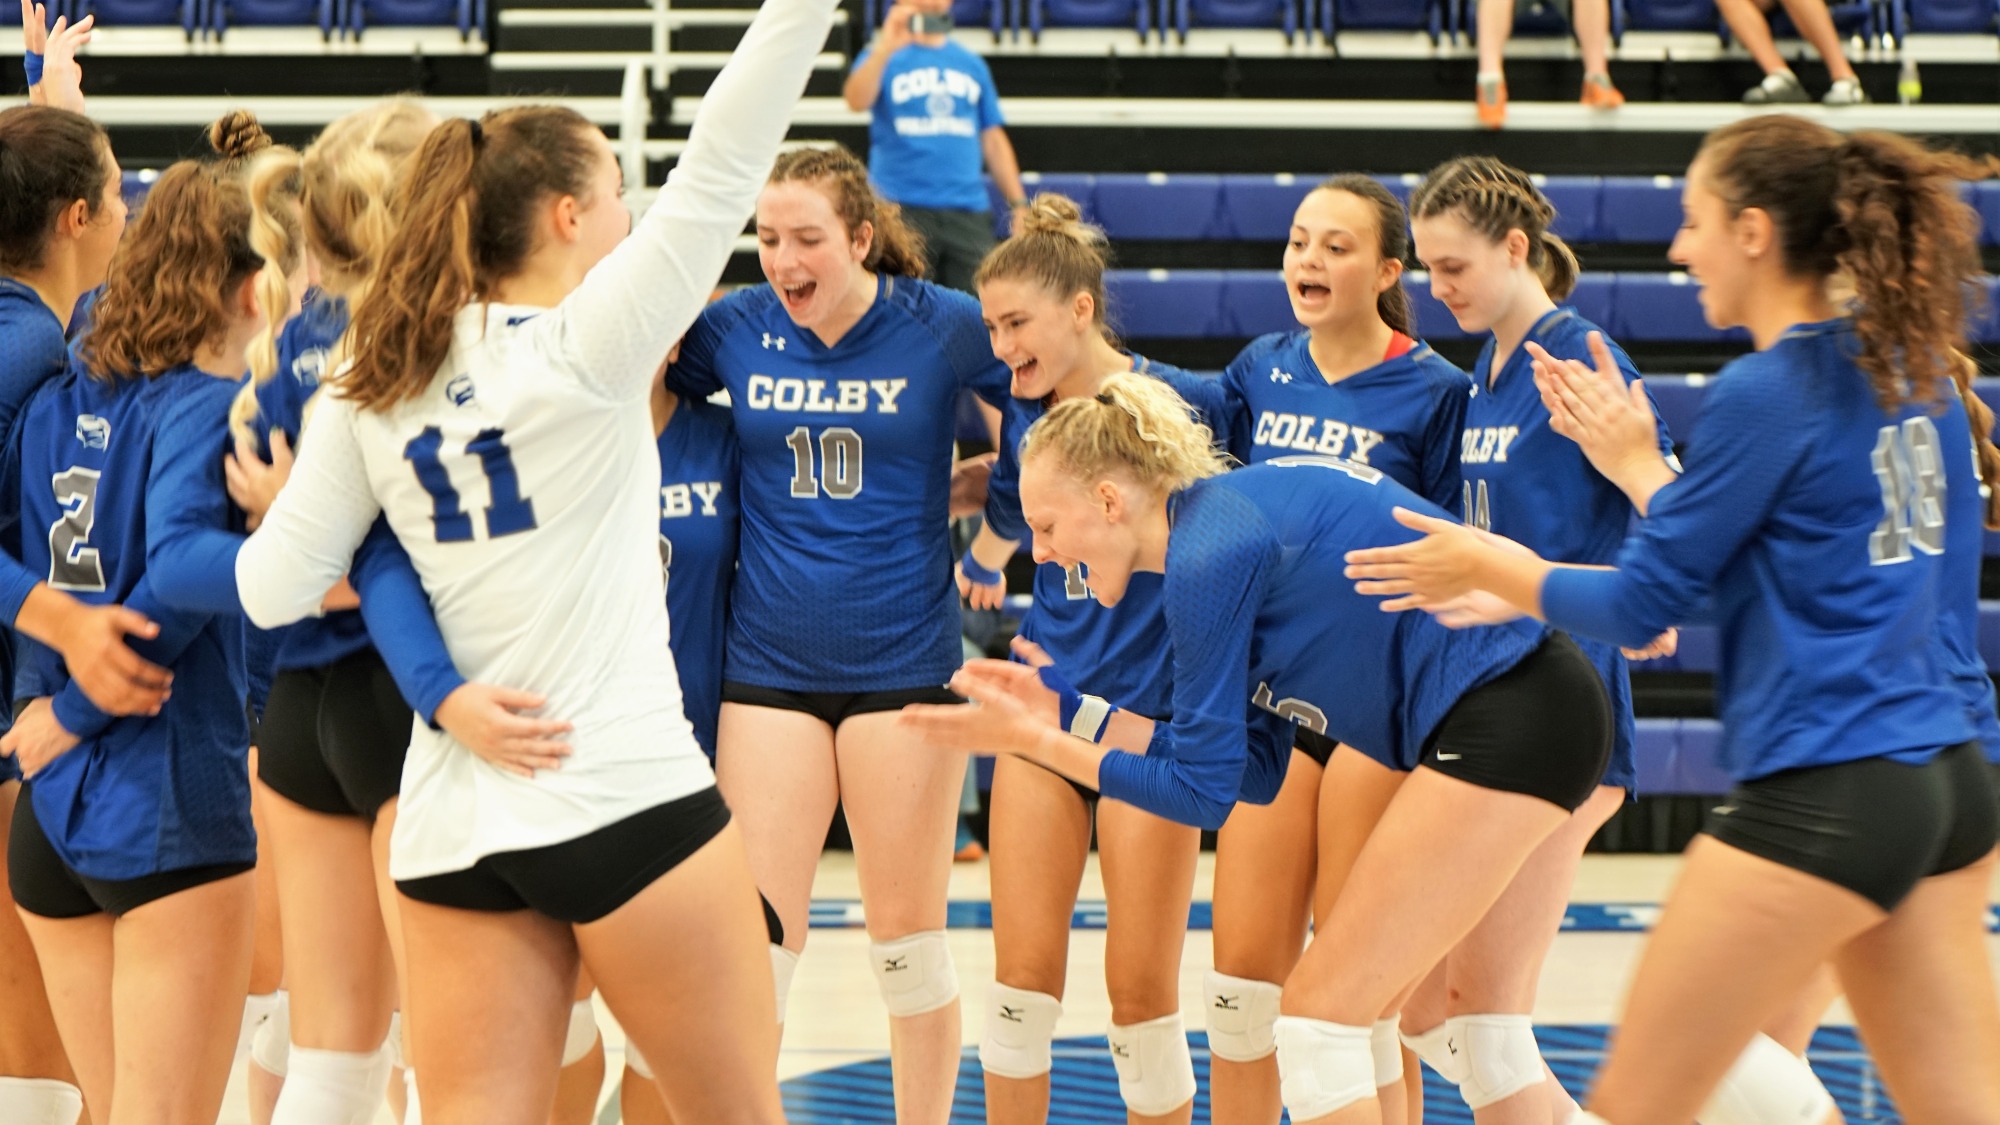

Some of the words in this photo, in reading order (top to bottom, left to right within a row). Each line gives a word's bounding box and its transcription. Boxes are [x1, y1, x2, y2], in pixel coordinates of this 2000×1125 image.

[747, 374, 908, 414] COLBY
[785, 426, 862, 499] 10
[1253, 410, 1384, 464] COLBY
[1461, 425, 1519, 464] OLBY
[403, 425, 538, 543] 11
[661, 481, 722, 518] BY
[1868, 415, 1948, 566] 18
[48, 465, 106, 592] 2
